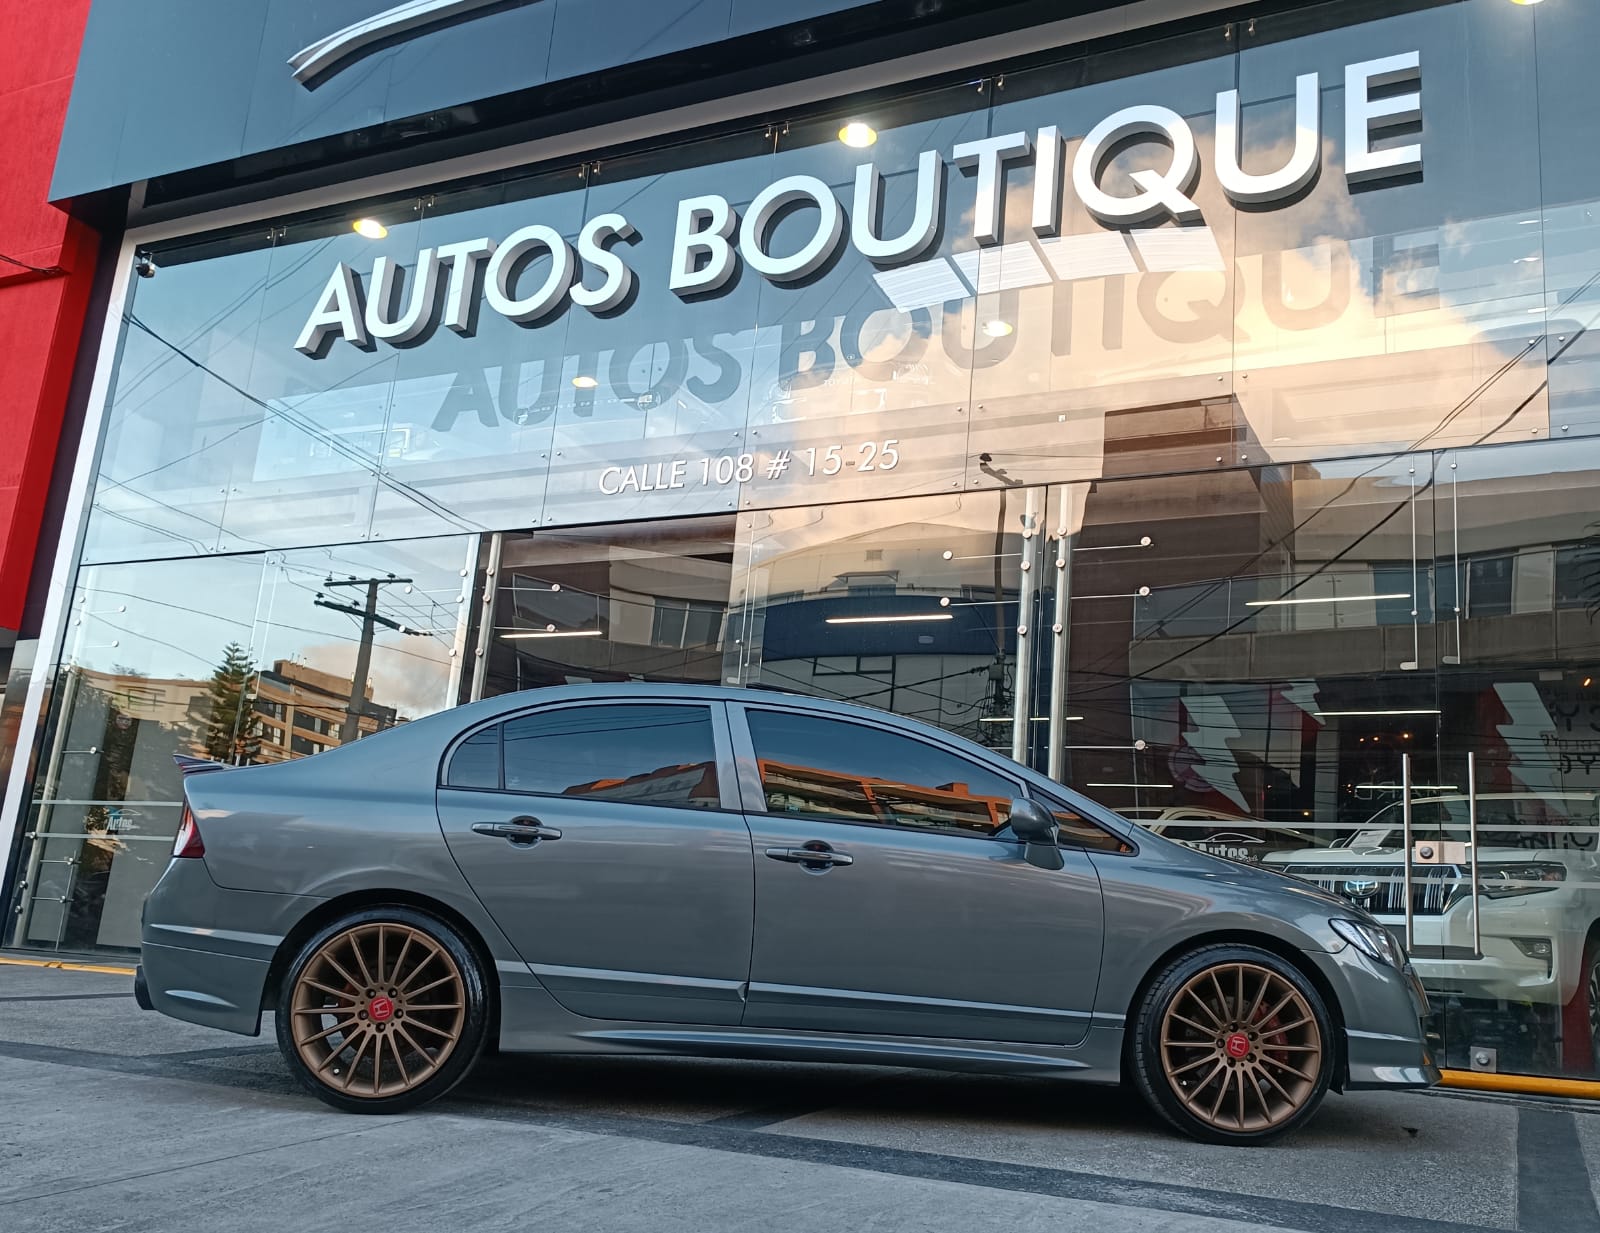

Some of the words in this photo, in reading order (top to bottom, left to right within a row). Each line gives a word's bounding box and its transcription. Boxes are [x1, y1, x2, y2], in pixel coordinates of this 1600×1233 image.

[294, 212, 637, 356] AUTOS
[668, 50, 1423, 296] BOUTIQUE
[598, 459, 687, 495] CALLE
[699, 453, 755, 486] 108
[766, 449, 791, 480] #
[804, 439, 900, 477] 15-25
